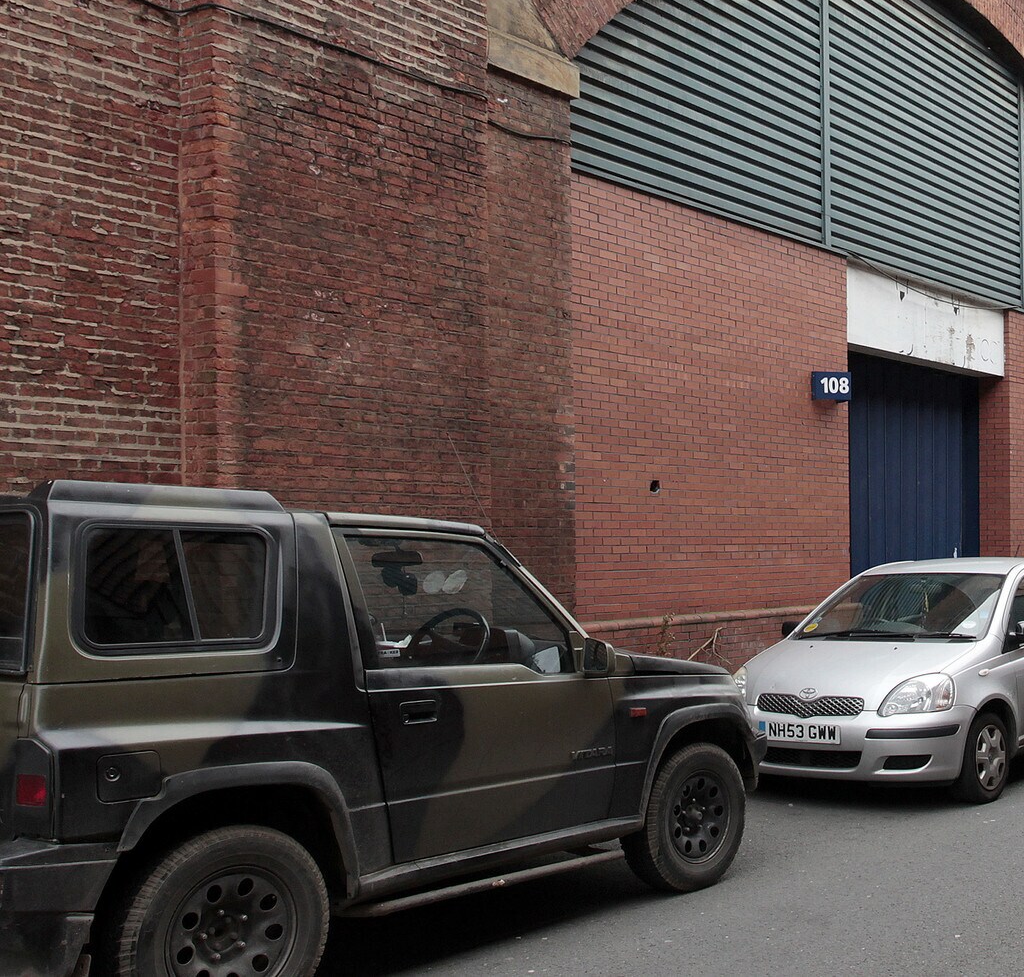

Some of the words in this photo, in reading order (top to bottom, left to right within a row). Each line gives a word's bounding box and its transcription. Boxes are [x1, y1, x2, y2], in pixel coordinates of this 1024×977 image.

[820, 376, 850, 394] 108
[768, 722, 804, 739] NH53
[808, 724, 836, 741] GWW
